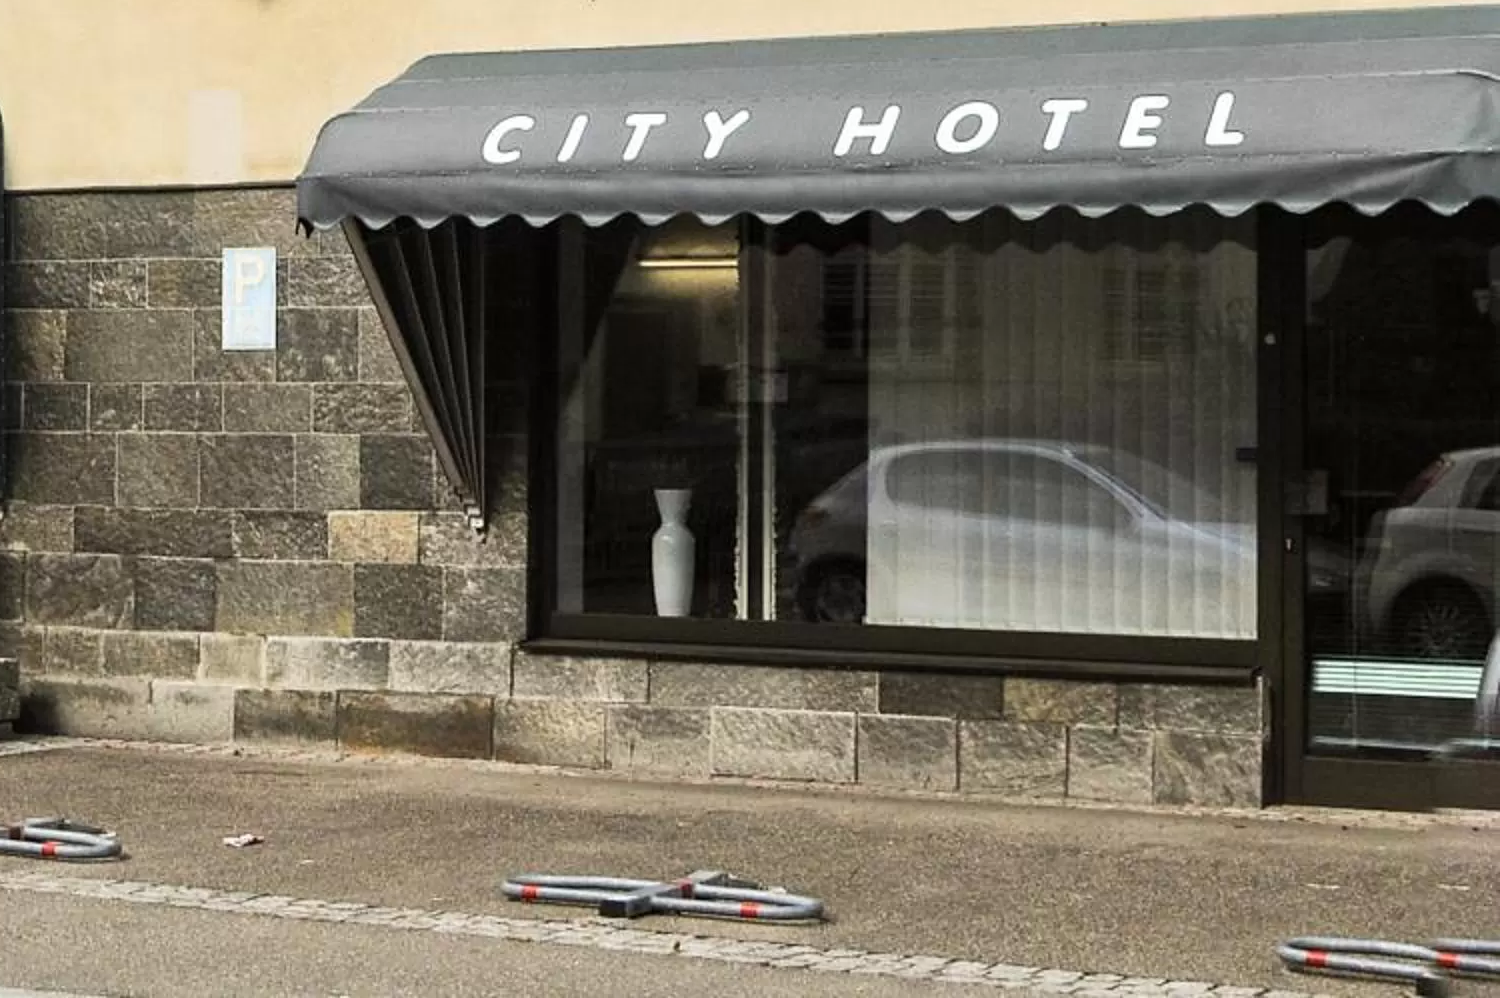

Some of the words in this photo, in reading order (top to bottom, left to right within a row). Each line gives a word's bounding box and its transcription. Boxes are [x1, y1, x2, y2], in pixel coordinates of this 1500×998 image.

[482, 109, 750, 164] CITY
[833, 91, 1245, 157] HOTEL
[234, 254, 265, 305] P
